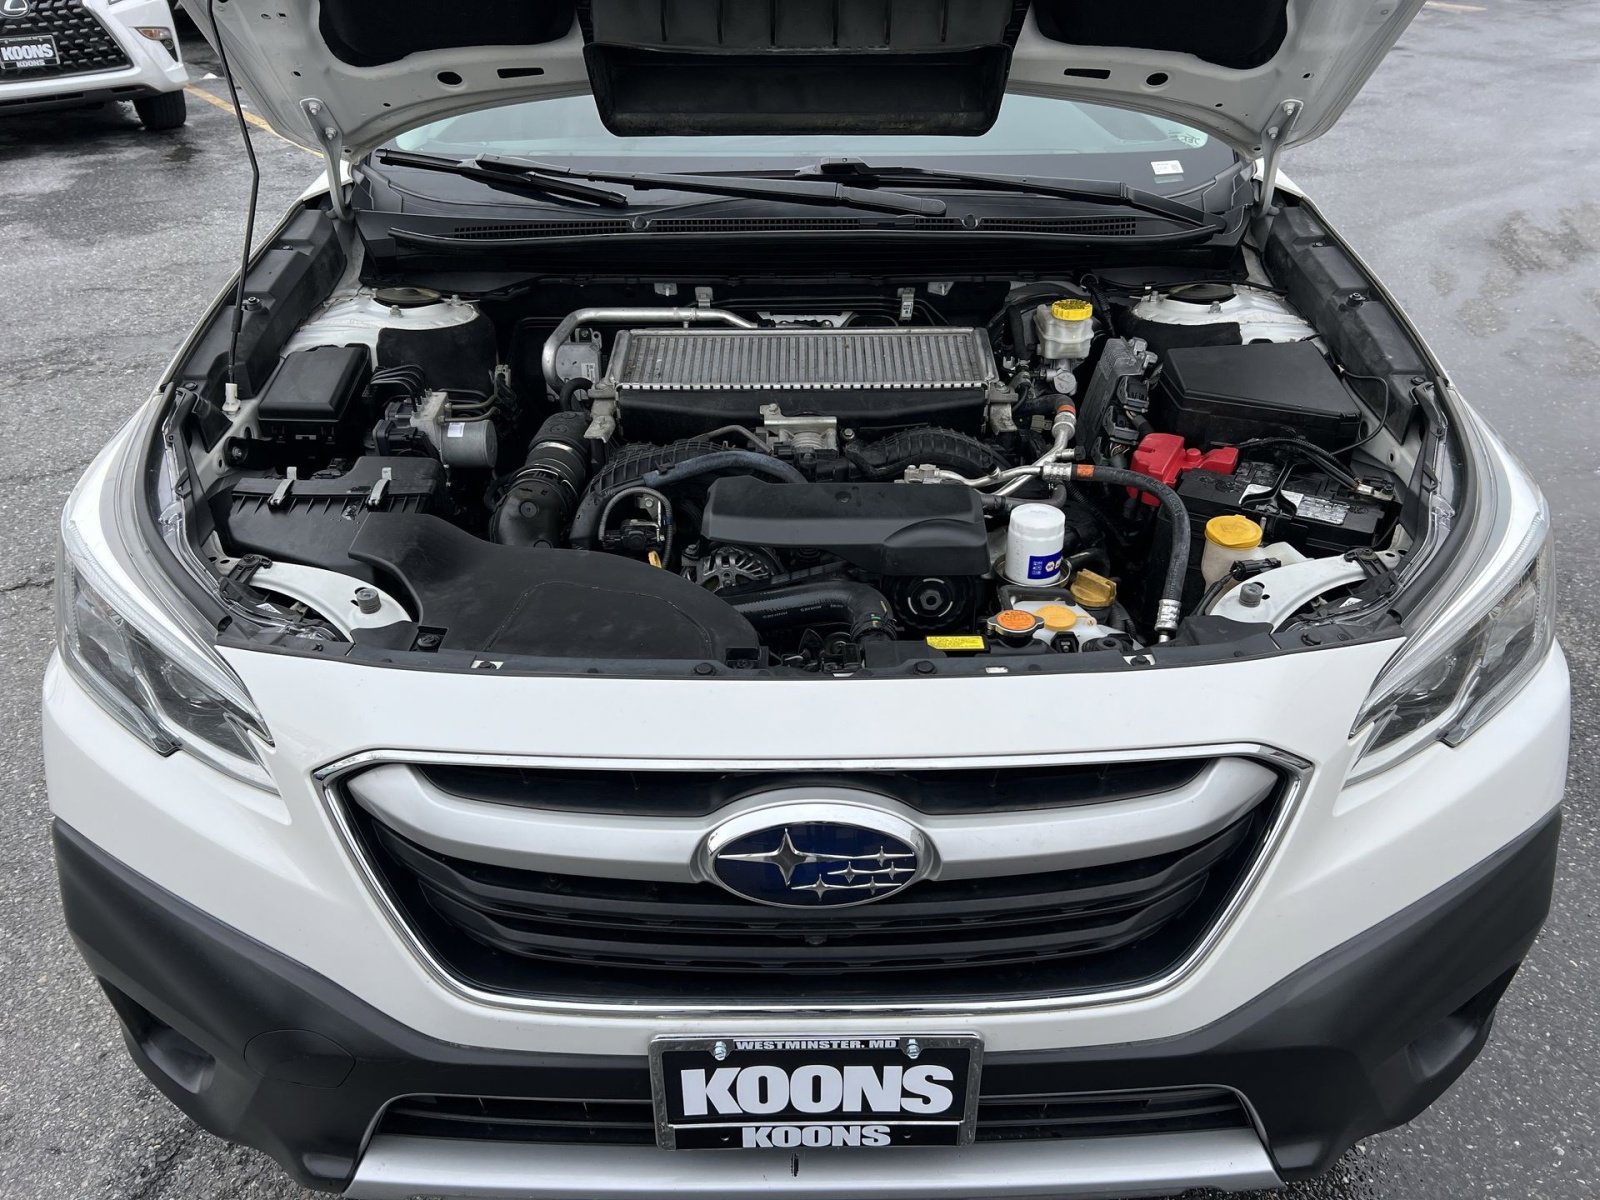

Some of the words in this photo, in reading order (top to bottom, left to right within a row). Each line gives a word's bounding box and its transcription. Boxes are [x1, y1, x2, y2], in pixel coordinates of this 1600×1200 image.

[1, 44, 53, 60] KOONS
[869, 1040, 897, 1048] MD
[681, 1065, 954, 1116] KOONS
[742, 1125, 891, 1148] KOONS
